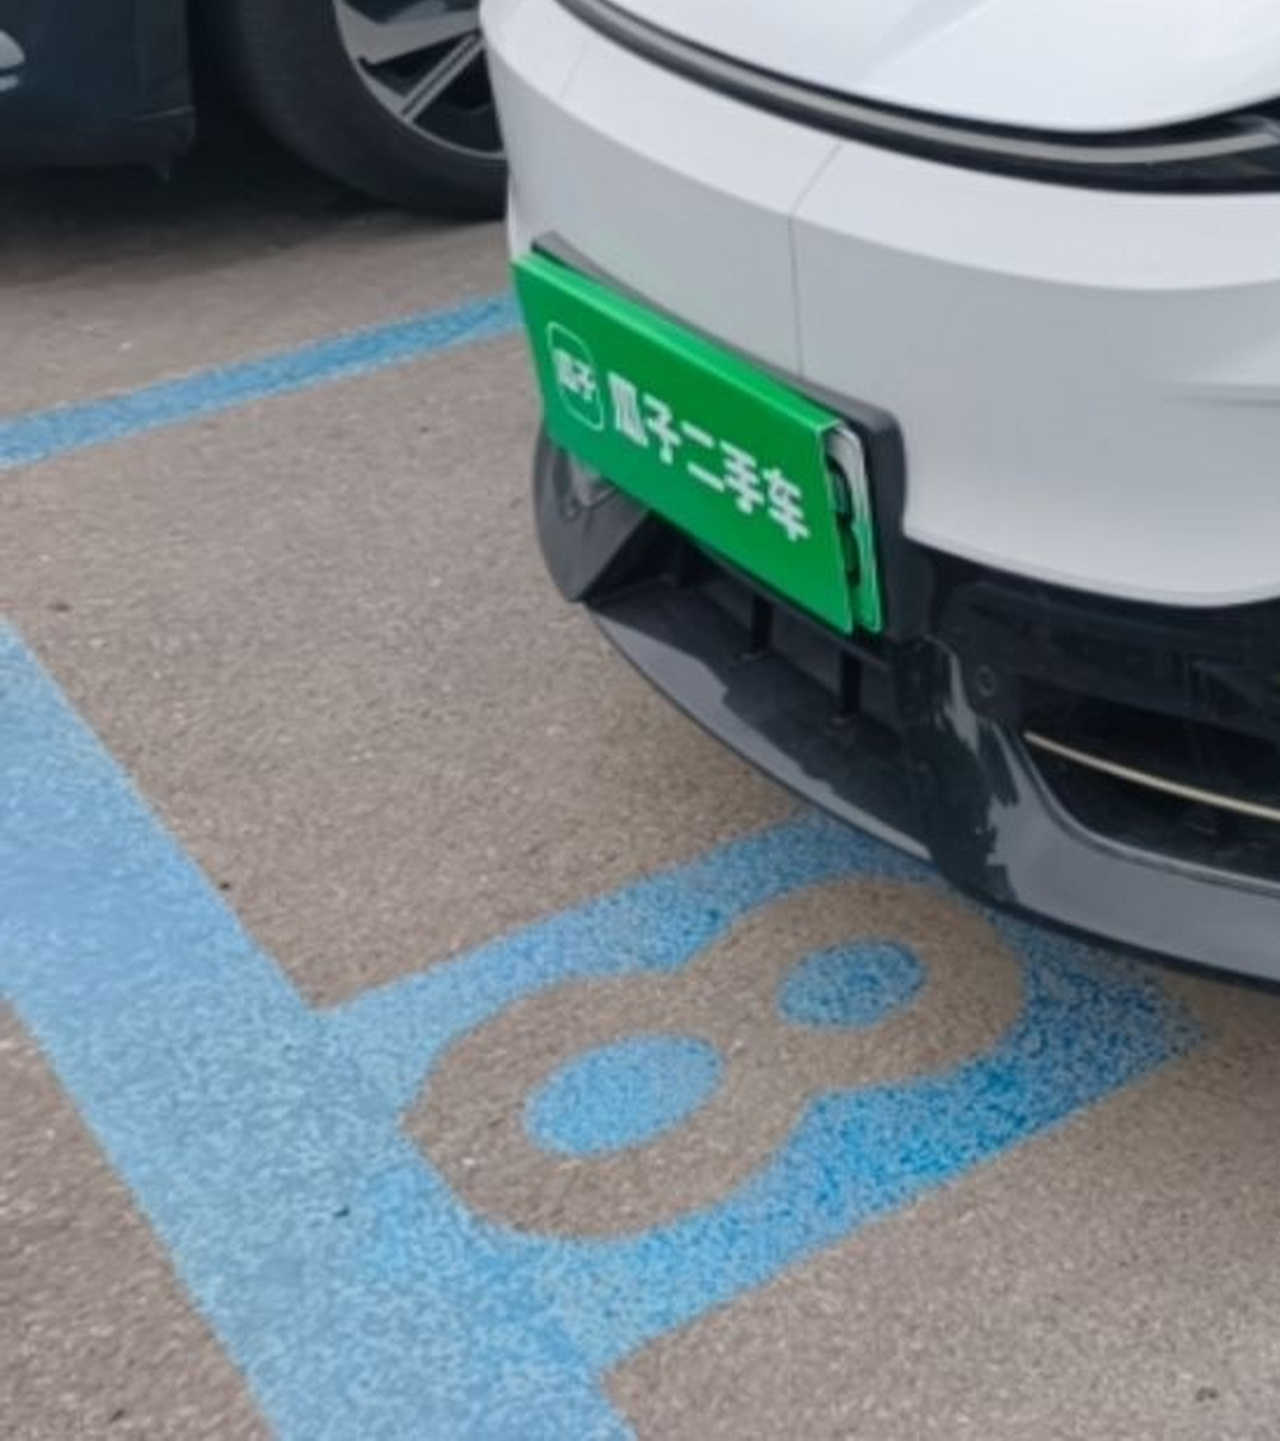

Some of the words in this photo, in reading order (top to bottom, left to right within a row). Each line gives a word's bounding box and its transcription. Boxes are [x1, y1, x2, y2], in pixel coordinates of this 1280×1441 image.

[607, 371, 810, 542] 瓜子二手车
[401, 878, 1027, 1241] 8
